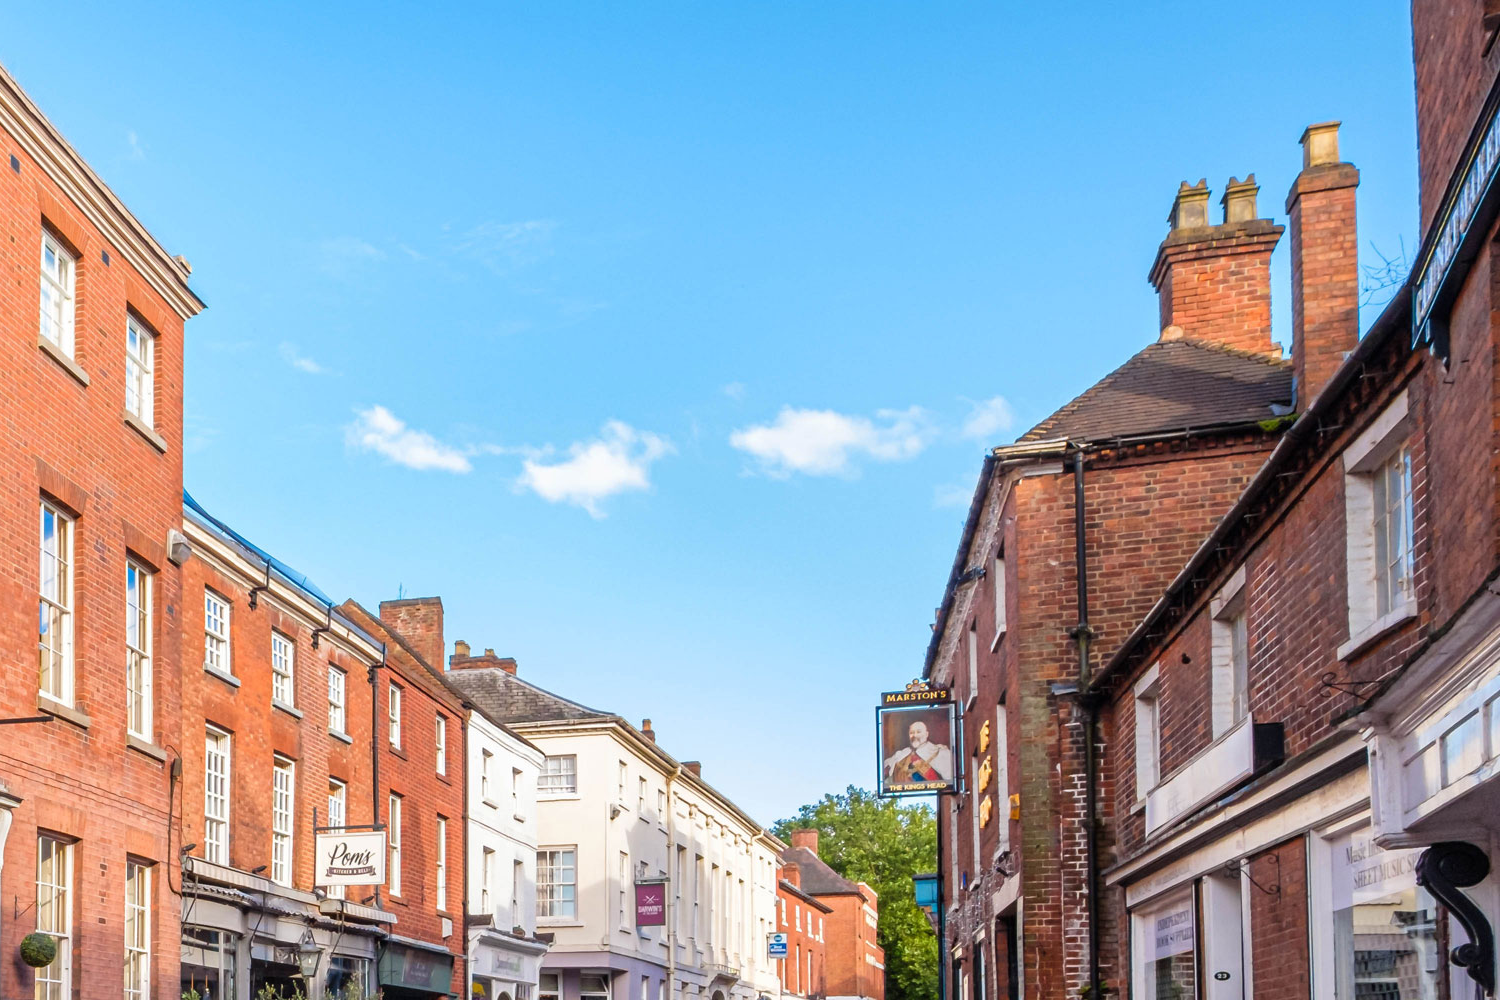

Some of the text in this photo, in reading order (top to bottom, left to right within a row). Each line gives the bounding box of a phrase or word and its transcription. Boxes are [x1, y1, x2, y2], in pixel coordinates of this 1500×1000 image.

[886, 690, 947, 703] MARSTON'S
[889, 782, 947, 792] THE KINGS HEAD
[328, 842, 376, 866] Pom's
[1353, 865, 1378, 889] SHEET
[1379, 857, 1405, 882] MUSIC
